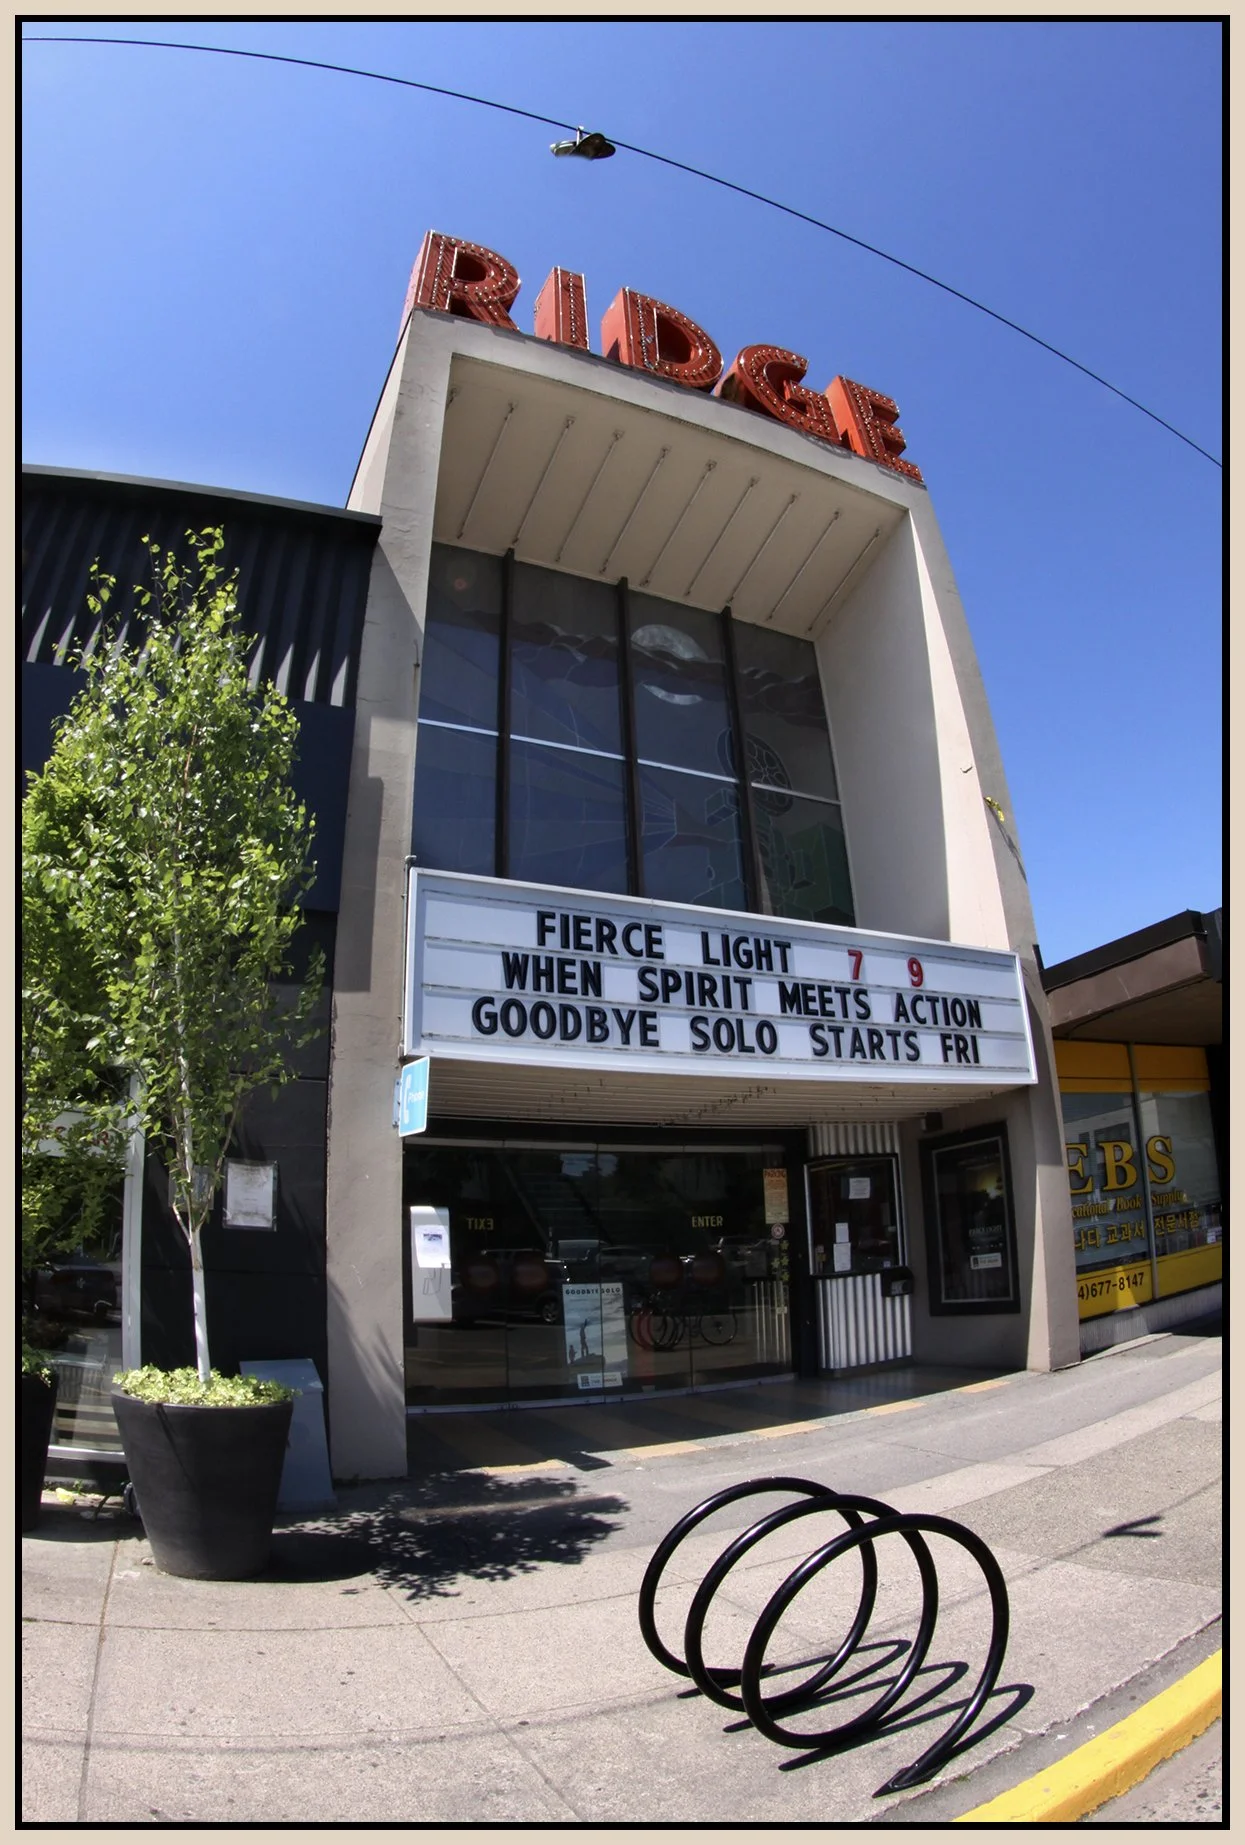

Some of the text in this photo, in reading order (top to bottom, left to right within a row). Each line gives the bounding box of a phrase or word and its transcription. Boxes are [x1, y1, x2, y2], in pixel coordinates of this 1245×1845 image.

[405, 229, 924, 483] RIDGE
[536, 910, 924, 988] FIERCE LIGHT 7 9
[501, 951, 982, 1028] WHEN SPIRIT MEETS ACTION
[471, 996, 980, 1063] GOODBYE SOLO STARTS FRI
[691, 1215, 723, 1228] ENTER
[1106, 1222, 1145, 1245] 교과서
[1154, 1210, 1200, 1237] 전문서점
[1116, 1194, 1142, 1212] Book
